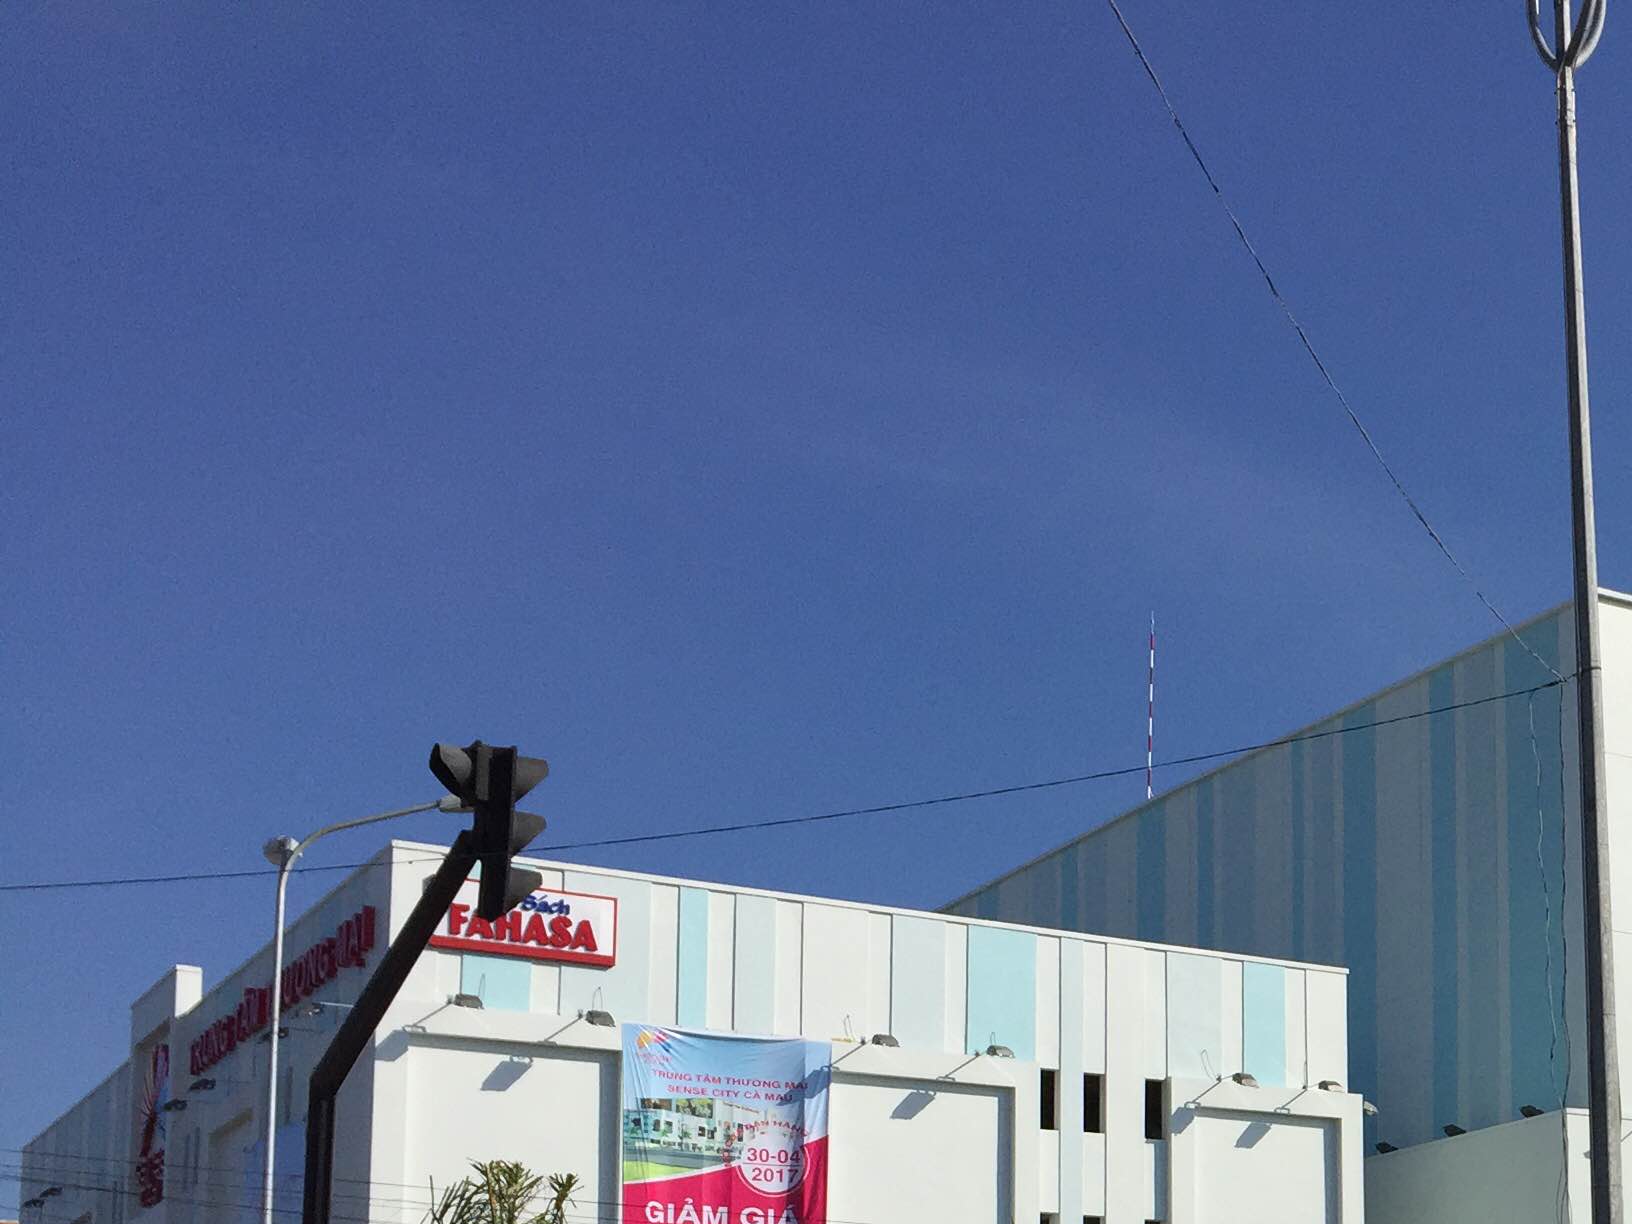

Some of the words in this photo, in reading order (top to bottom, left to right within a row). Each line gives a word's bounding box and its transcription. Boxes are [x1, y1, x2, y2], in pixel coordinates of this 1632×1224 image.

[448, 902, 598, 953] FAHASA
[652, 1068, 693, 1083] TRUNG
[695, 1071, 722, 1086] TÂM
[667, 1084, 708, 1096] SENSE
[711, 1087, 741, 1099] CITY
[763, 1092, 794, 1102] MAU
[746, 1146, 801, 1164] 30-04
[751, 1167, 799, 1183] 2017
